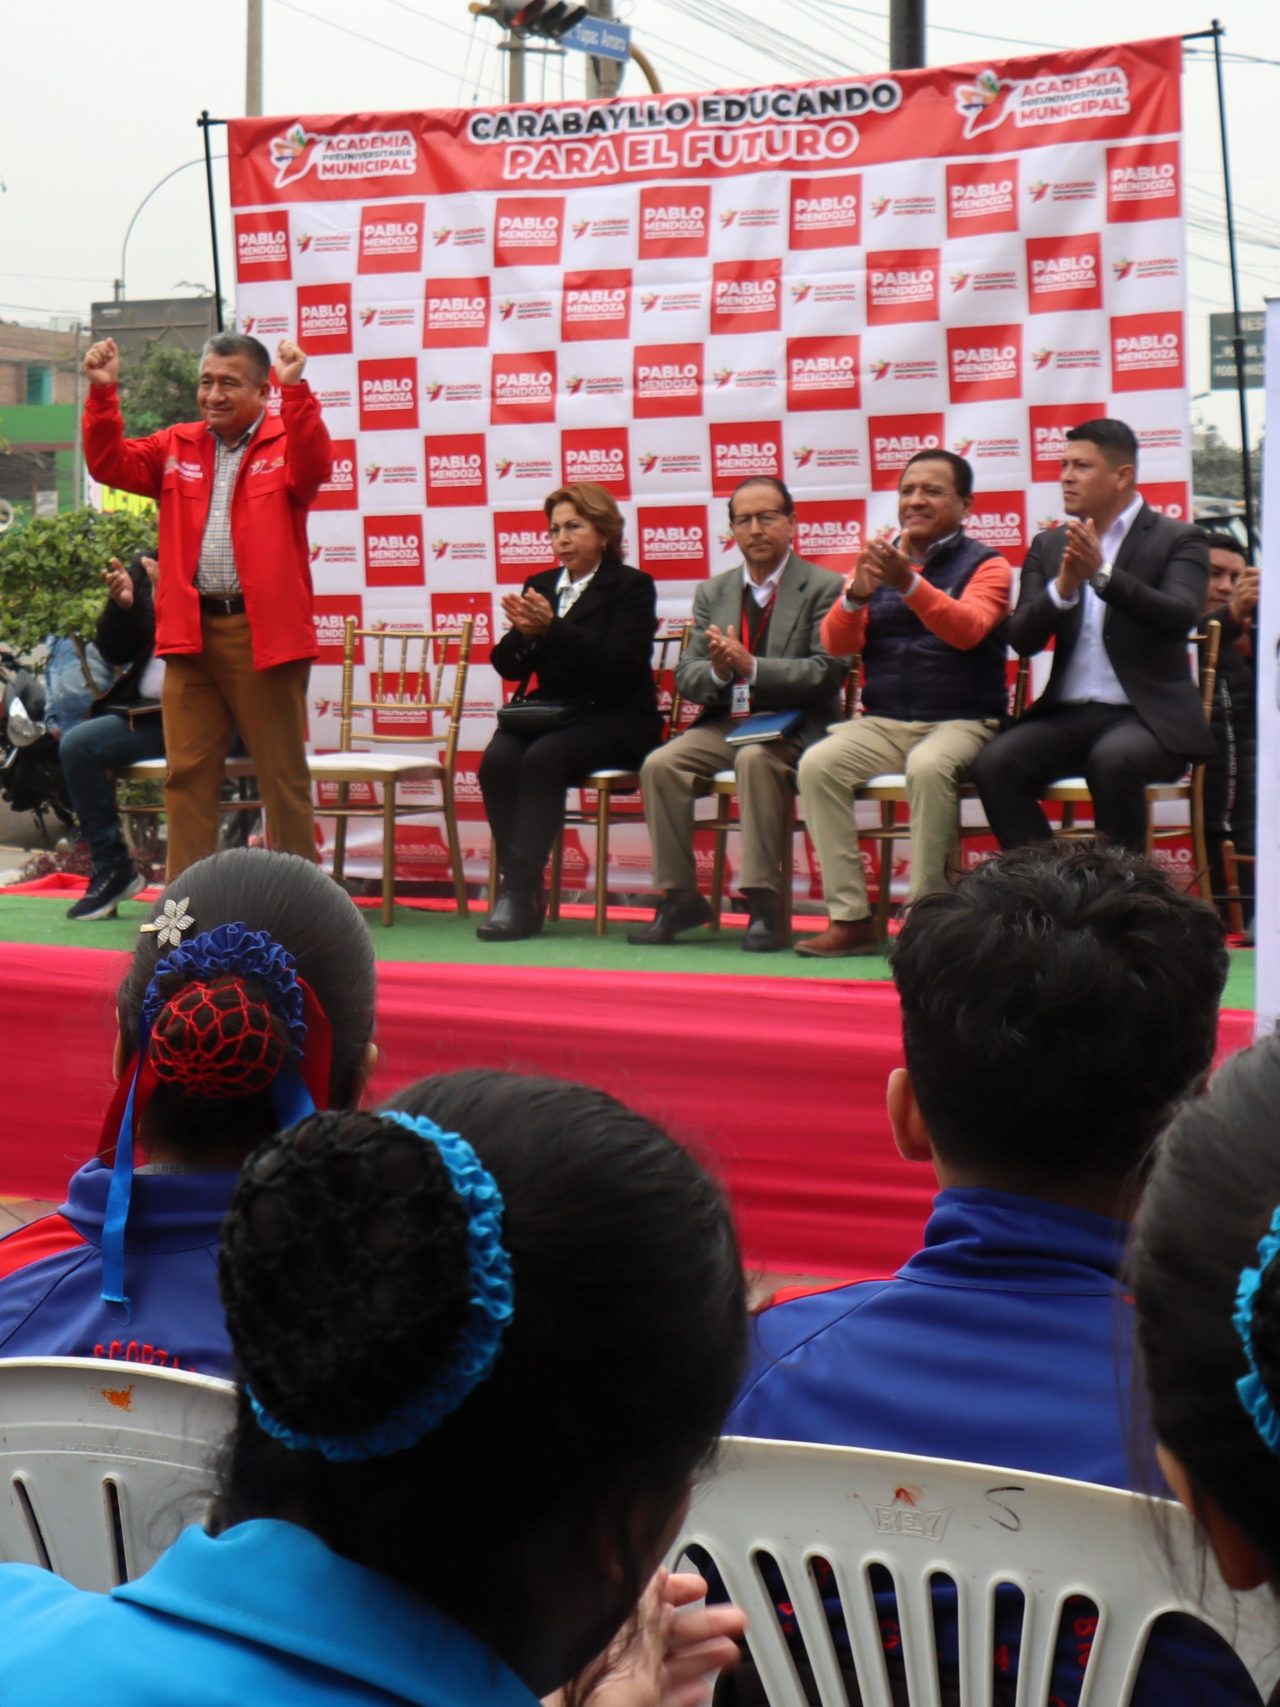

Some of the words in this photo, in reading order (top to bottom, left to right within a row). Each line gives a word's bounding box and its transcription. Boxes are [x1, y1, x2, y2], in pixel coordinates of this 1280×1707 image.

[1022, 72, 1121, 96] ACADEMIA
[1020, 88, 1123, 106] PREUNIVERSITARIA
[471, 103, 690, 140] CARABAYLLO
[703, 84, 896, 122] EDUCANDO
[1020, 99, 1125, 122] MUNICIPAL
[325, 135, 411, 152] ACADEMIA
[323, 150, 412, 161] PREUNIVERSITARIA
[506, 143, 616, 178] PARA
[628, 136, 676, 166] EL
[687, 125, 854, 165] FUTURO
[322, 159, 411, 175] MUNICIPAL
[1112, 165, 1175, 181] PABLO
[951, 181, 1013, 198] PABLO
[1112, 179, 1175, 193] MENDOZA
[795, 196, 856, 211] PABLO
[951, 195, 1013, 210] MENDOZA
[644, 207, 704, 220] PABLO
[795, 209, 856, 222] MENDOZA
[363, 222, 417, 237] PABLO
[499, 217, 558, 229] PABLO
[644, 220, 704, 231] MENDOZA
[240, 231, 285, 246] PABLO
[498, 229, 557, 240] MENDOZA
[363, 236, 417, 248] MENDOZA
[240, 246, 287, 256] MENDOZA
[1032, 255, 1095, 272] PABLO
[872, 270, 934, 285] PABLO
[1033, 270, 1095, 285] MENDOZA
[716, 280, 775, 296] PABLO
[872, 284, 934, 297] MENDOZA
[566, 290, 625, 303] PABLO
[716, 294, 775, 307] MENDOZA
[302, 304, 346, 319] PABLO
[429, 298, 485, 311] PABLO
[566, 302, 625, 314] MENDOZA
[428, 310, 485, 321] MENDOZA
[301, 319, 347, 329] MENDOZA
[1117, 334, 1177, 352] PABLO
[953, 347, 1016, 363] PABLO
[1117, 349, 1178, 363] MENDOZA
[792, 357, 854, 371] PABLO
[954, 361, 1016, 374] MENDOZA
[496, 372, 552, 386] PABLO
[638, 365, 697, 379] PABLO
[792, 371, 854, 382] MENDOZA
[363, 379, 412, 393] PABLO
[496, 386, 551, 397] MENDOZA
[639, 379, 697, 390] MENDOZA
[363, 392, 412, 402] MENDOZA
[716, 443, 776, 458] PABLO
[875, 436, 939, 452] PABLO
[430, 455, 480, 469] PABLO
[566, 450, 623, 463] PABLO
[717, 458, 777, 468] MENDOZA
[430, 469, 481, 479] MENDOZA
[567, 463, 623, 474] MENDOZA
[643, 527, 702, 541] PABLO
[798, 521, 860, 536] PABLO
[369, 536, 418, 550] PABLO
[644, 541, 703, 551] MENDOZA
[798, 537, 861, 547] MENDOZA
[369, 550, 419, 559] MENDOZA
[876, 1507, 941, 1538] REY
